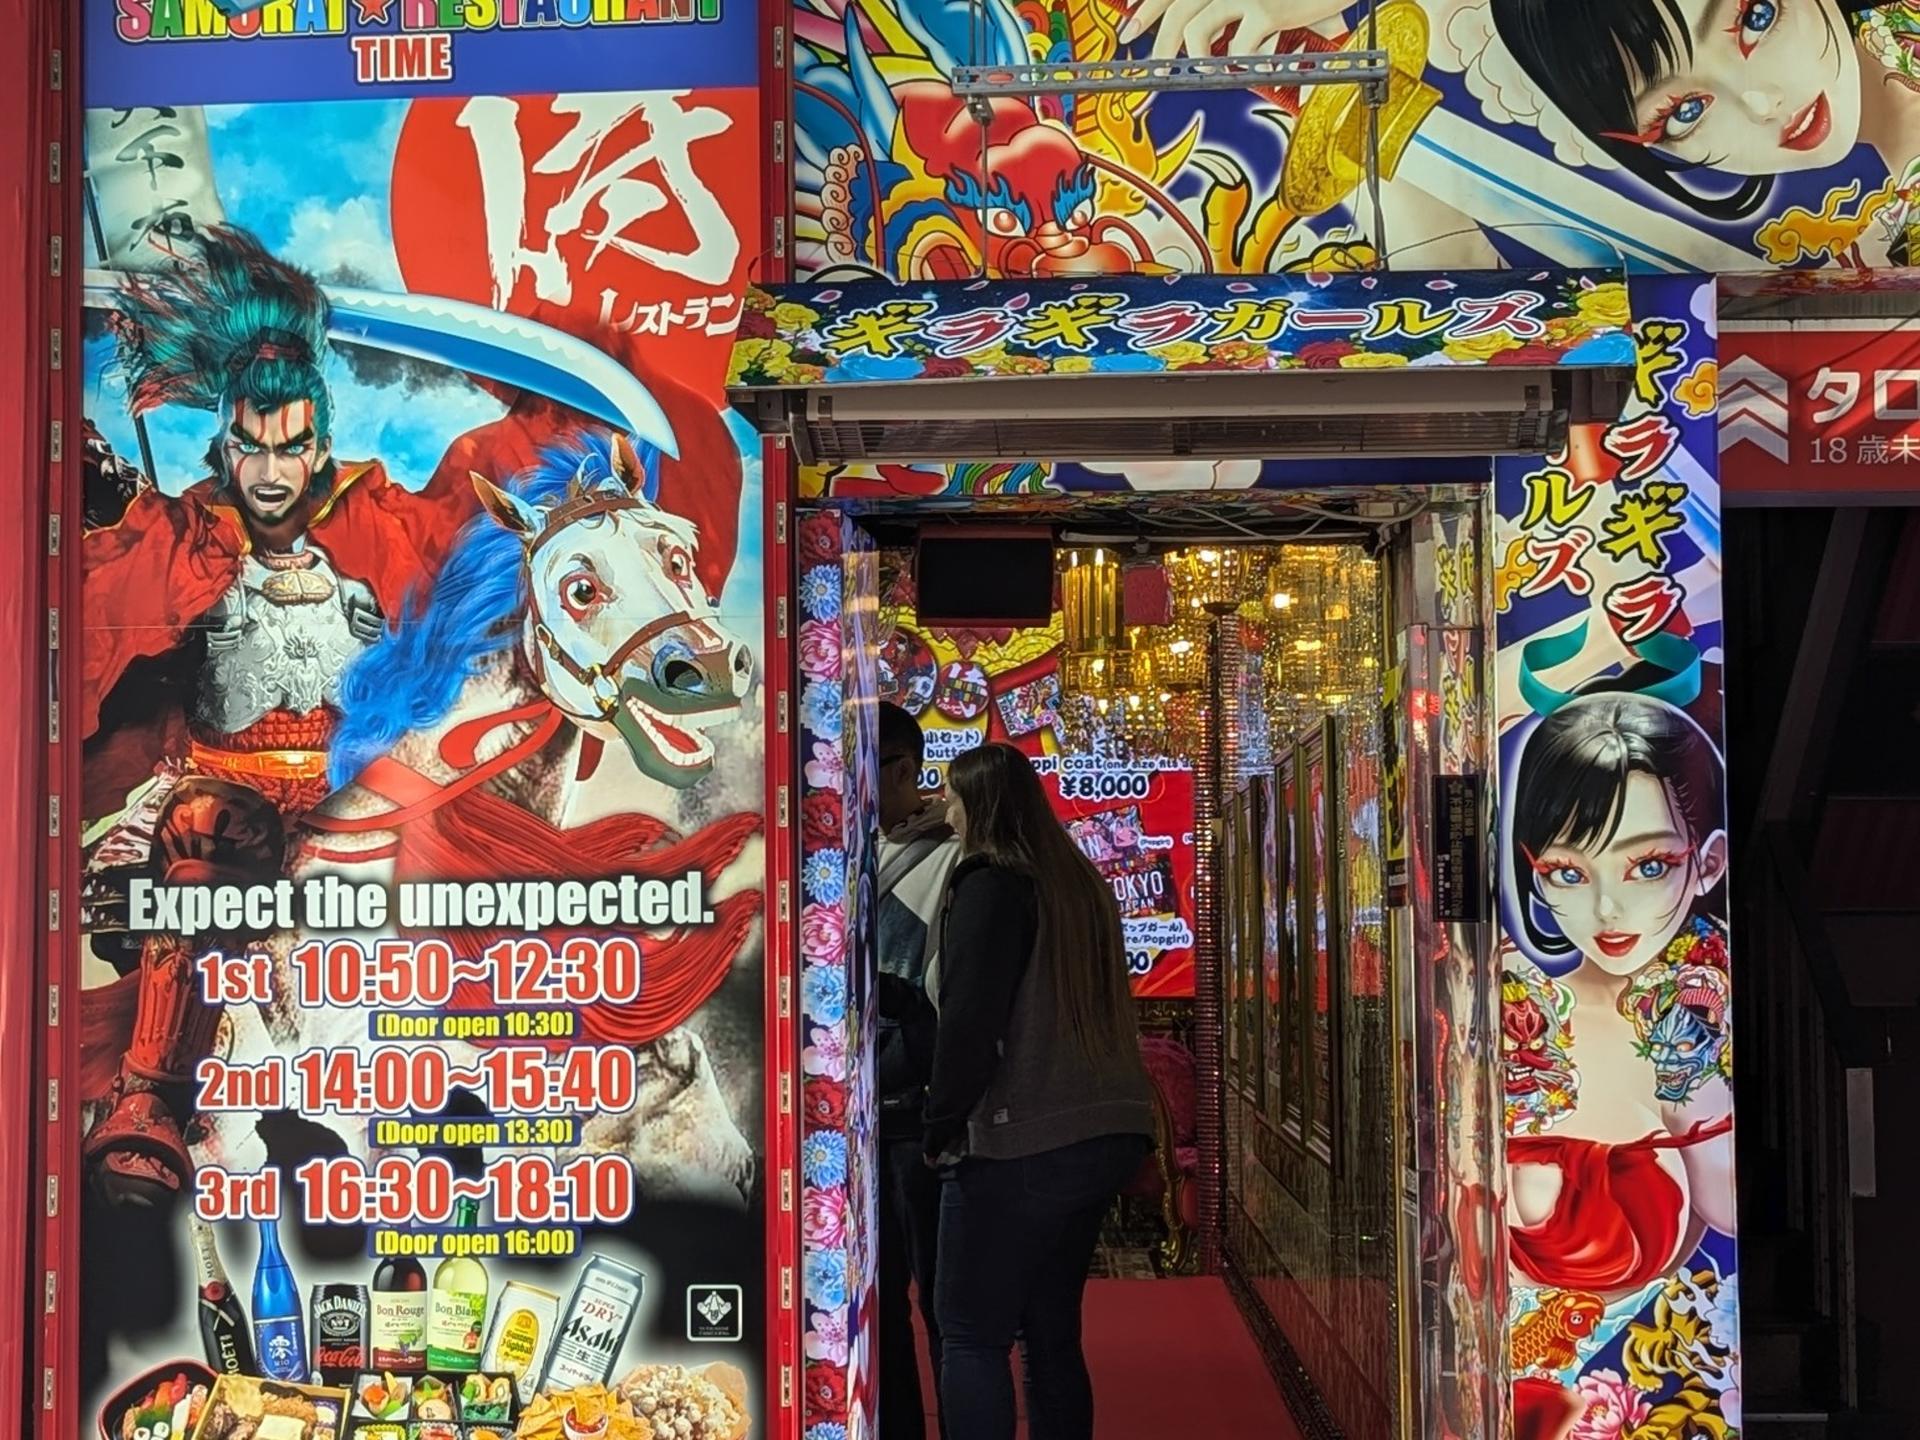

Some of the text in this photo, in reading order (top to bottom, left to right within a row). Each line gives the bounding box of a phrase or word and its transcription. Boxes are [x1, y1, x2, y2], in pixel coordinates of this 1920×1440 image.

[354, 36, 451, 81] TIME
[456, 90, 740, 312] 侍
[600, 288, 745, 336] レストラン
[824, 292, 1544, 358] ギラギラガールズ
[1810, 434, 1920, 464] 18 歳未
[1600, 319, 1690, 641] ギラギラ
[1520, 448, 1593, 597] ルズ
[927, 747, 962, 758] butt
[1064, 758, 1101, 769] coat
[1061, 775, 1147, 798] ¥8,000
[129, 871, 714, 935] Expect the unexpected.
[1108, 871, 1163, 901] OKYO
[199, 953, 271, 1002] 1st
[377, 1011, 574, 1038] (Door open 10:30)
[198, 1061, 281, 1107] 2nd
[376, 1119, 573, 1146] (Door open 13:30)
[197, 1170, 277, 1218] 3rd
[375, 1229, 575, 1256] (Door open 16:00)
[377, 1304, 424, 1317] Bon Rouge
[435, 1302, 453, 1315] Bon
[562, 1316, 622, 1356] Asahi
